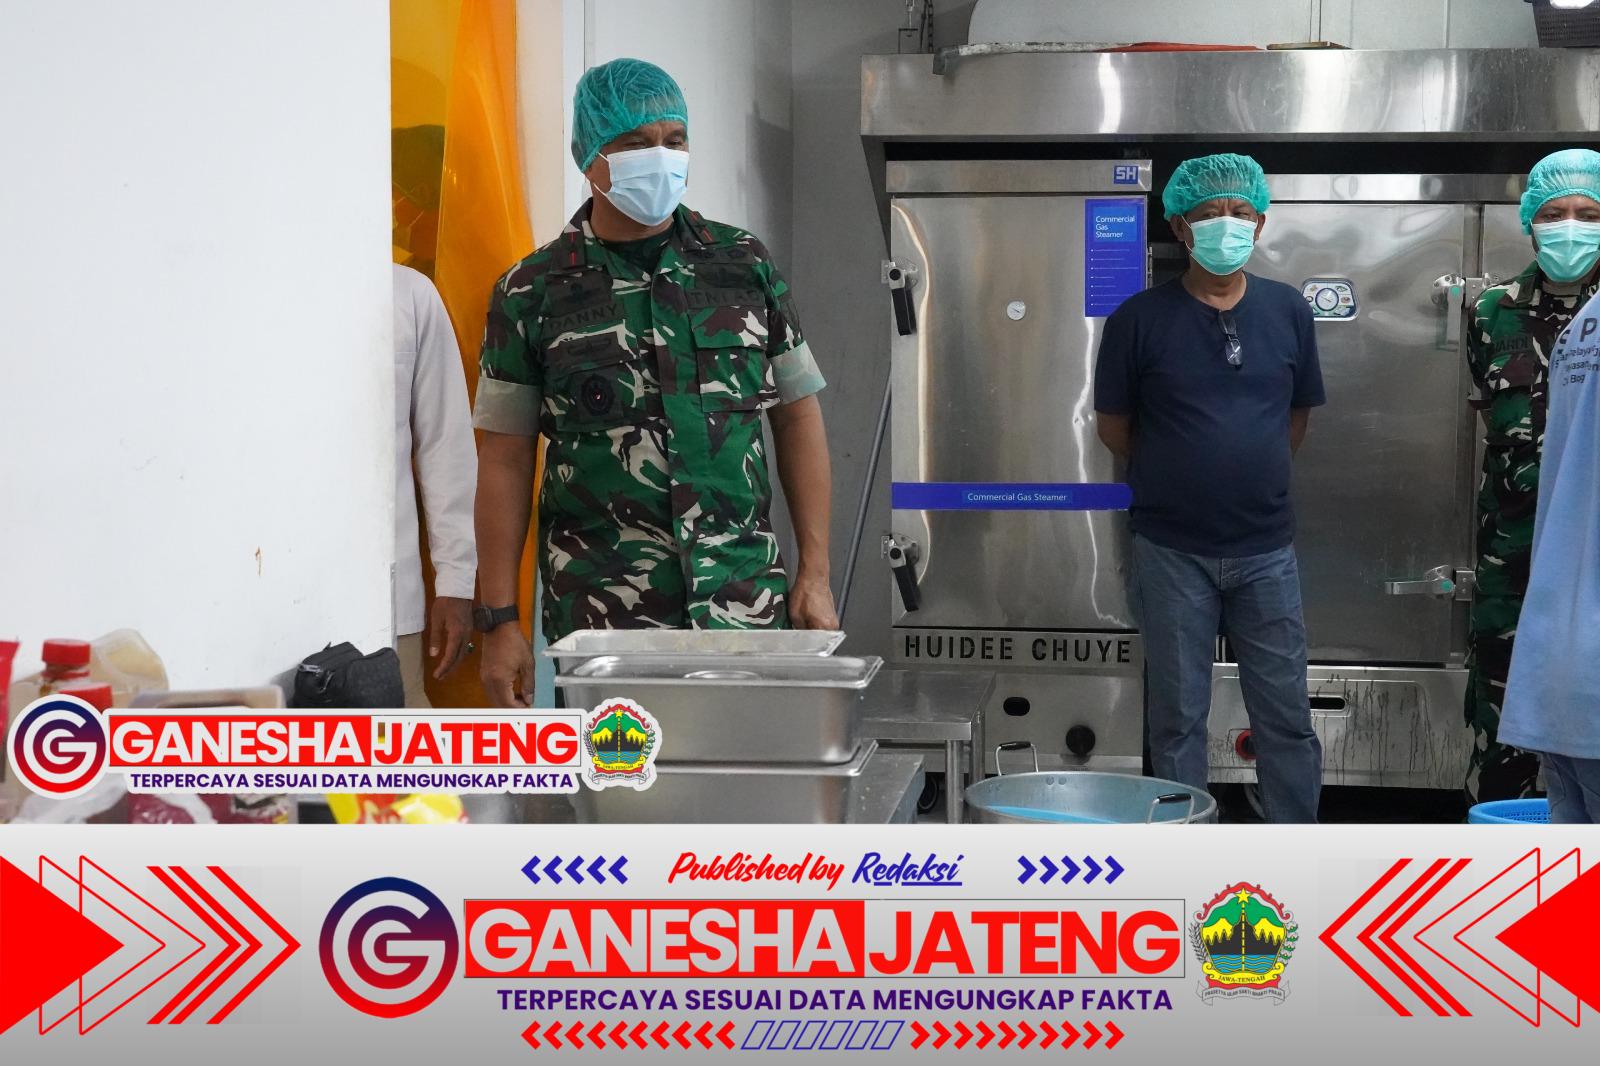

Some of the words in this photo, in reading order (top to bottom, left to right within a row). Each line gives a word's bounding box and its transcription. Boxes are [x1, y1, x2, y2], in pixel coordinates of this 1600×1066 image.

[1116, 166, 1137, 180] SH
[1095, 215, 1136, 223] Commercial
[1095, 223, 1109, 231] Gas
[967, 493, 1015, 501] Commercial
[1017, 493, 1032, 501] Gas
[1034, 493, 1067, 501] Steamer
[904, 635, 1013, 660] HUIDEE
[1031, 638, 1131, 663] CHUYE
